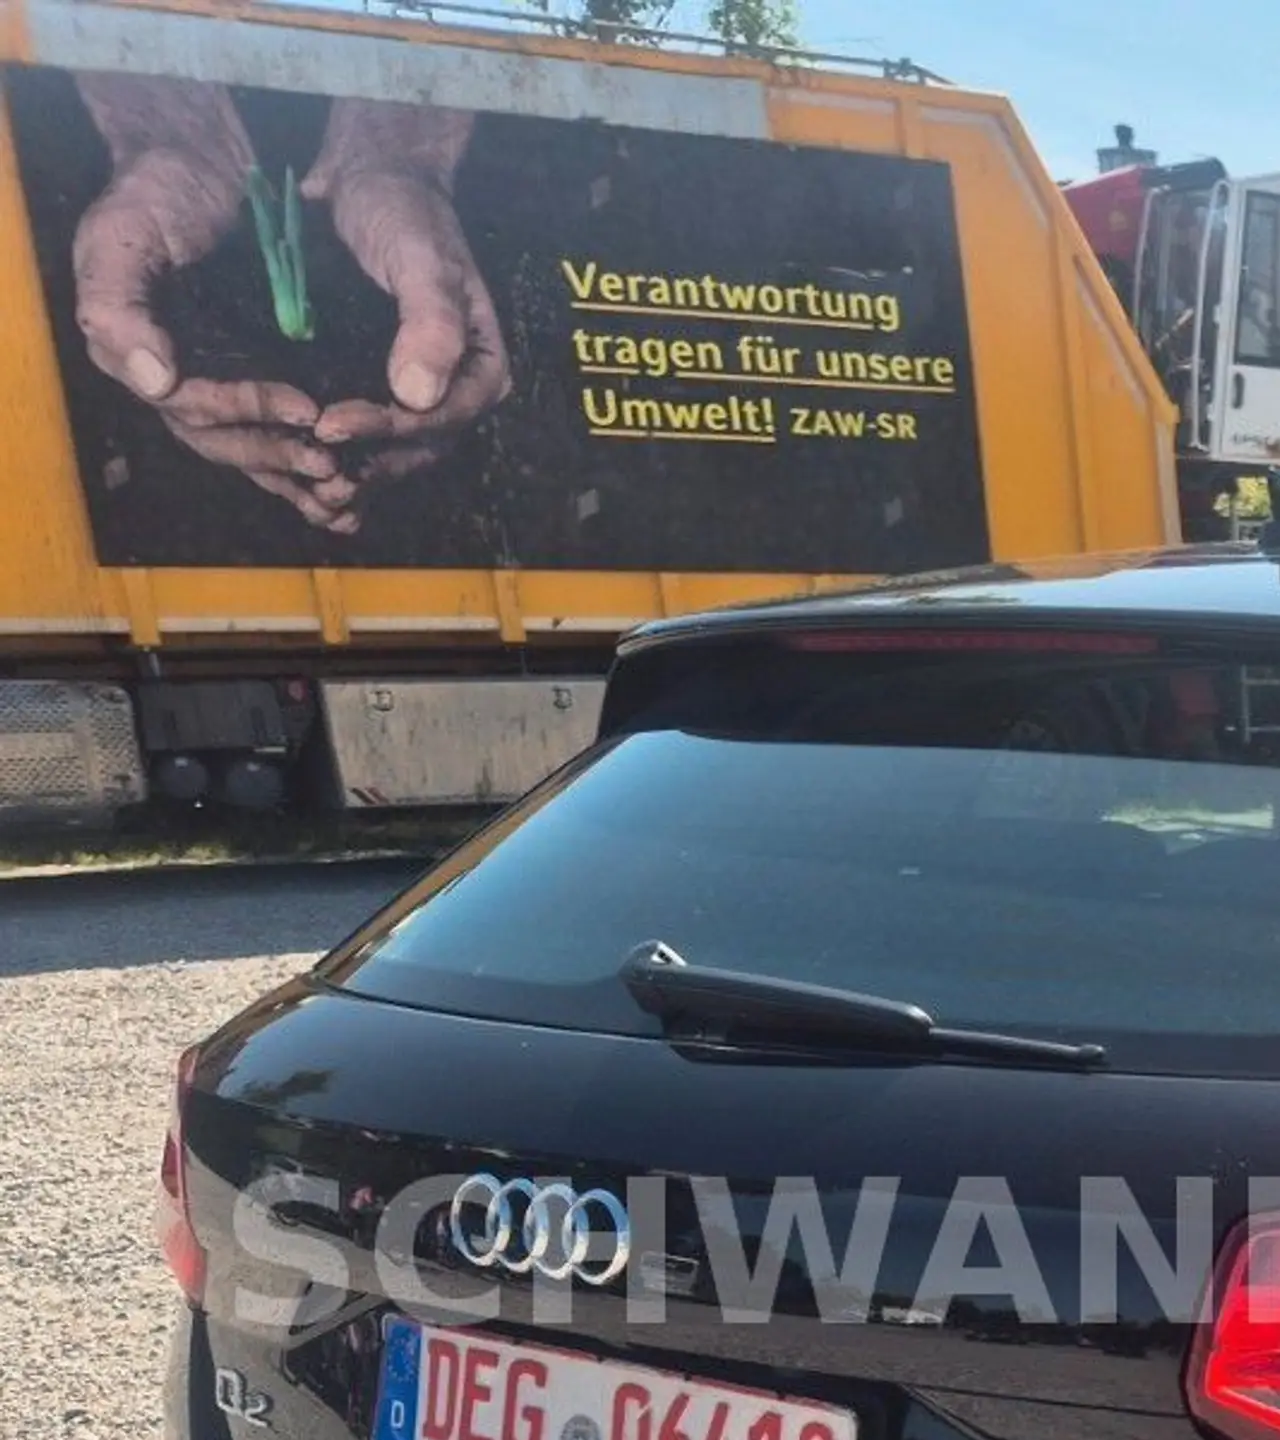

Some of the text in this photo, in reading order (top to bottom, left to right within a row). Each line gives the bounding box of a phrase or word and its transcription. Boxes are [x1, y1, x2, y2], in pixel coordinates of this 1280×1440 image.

[562, 260, 901, 332] Verantwortung
[572, 328, 955, 385] tragen für unsere
[582, 387, 918, 440] Umwelt! ZAW-SR
[215, 1367, 268, 1428] Q2
[390, 1399, 405, 1430] D
